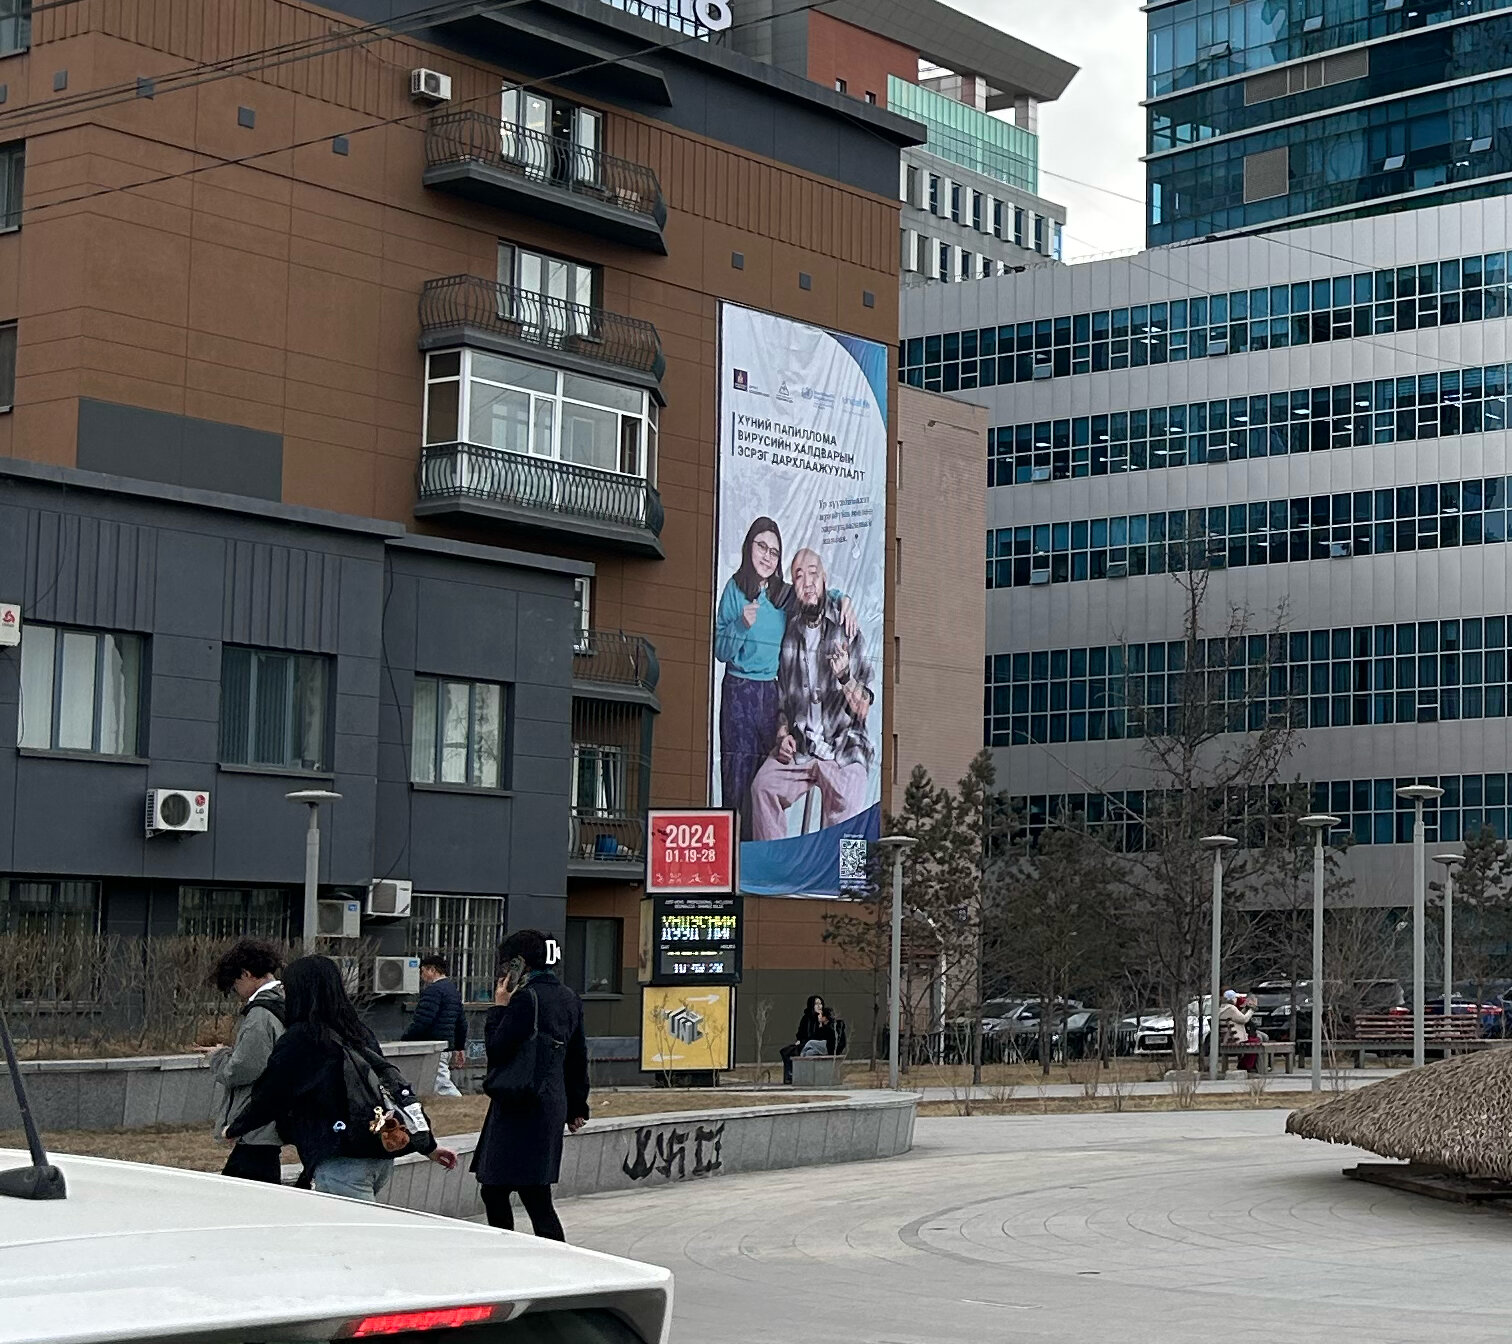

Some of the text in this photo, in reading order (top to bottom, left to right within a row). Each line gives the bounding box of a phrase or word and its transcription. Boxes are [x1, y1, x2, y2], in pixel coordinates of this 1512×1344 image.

[737, 429, 792, 451] ВИРУСИЙН
[774, 422, 837, 446] ПАПИЛЛОМА
[737, 445, 769, 461] ЭСРЭГ
[665, 824, 716, 848] 2024
[665, 849, 716, 863] 01.19-28
